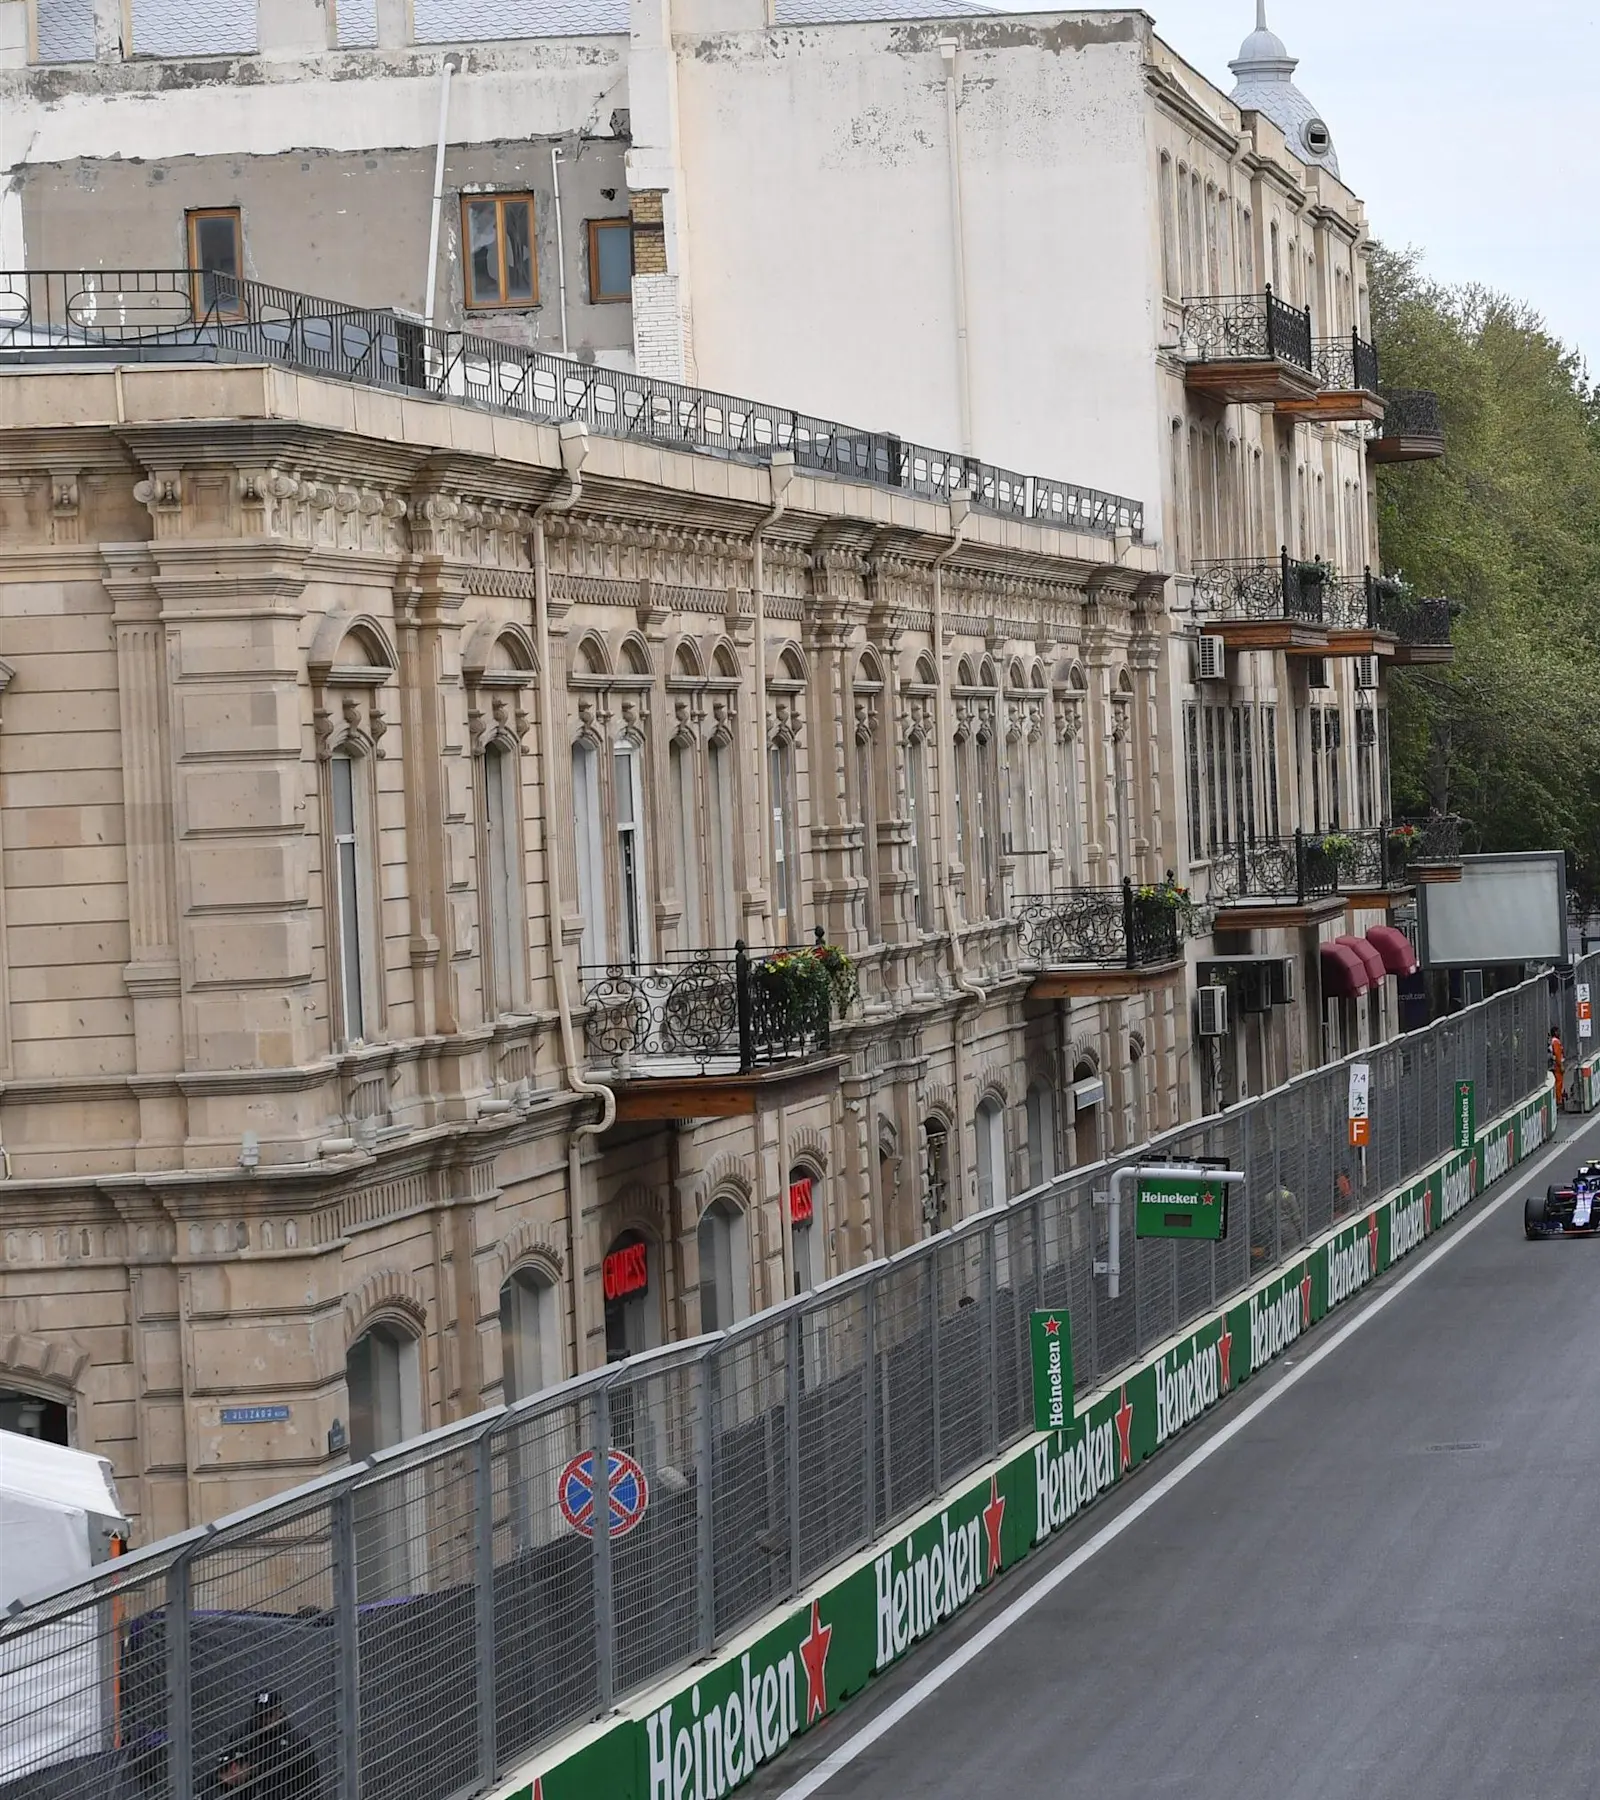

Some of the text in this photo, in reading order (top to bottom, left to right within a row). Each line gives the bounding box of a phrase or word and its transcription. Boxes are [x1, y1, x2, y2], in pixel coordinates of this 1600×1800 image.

[1581, 1003, 1589, 1018] F
[1352, 1073, 1366, 1083] 7.4
[1353, 1121, 1366, 1141] F
[1461, 1098, 1470, 1147] Heineken
[1141, 1192, 1198, 1204] Heineken
[1390, 1189, 1424, 1262] Heineken
[603, 1243, 646, 1300] GUESS
[1327, 1226, 1369, 1307] Heineken
[1250, 1278, 1300, 1372] Heineken
[1047, 1340, 1064, 1427] Heineken
[1155, 1336, 1218, 1444] Heineken
[1034, 1413, 1114, 1540] Heineken
[874, 1512, 982, 1668] Heineken
[647, 1653, 798, 1800] Heineken
